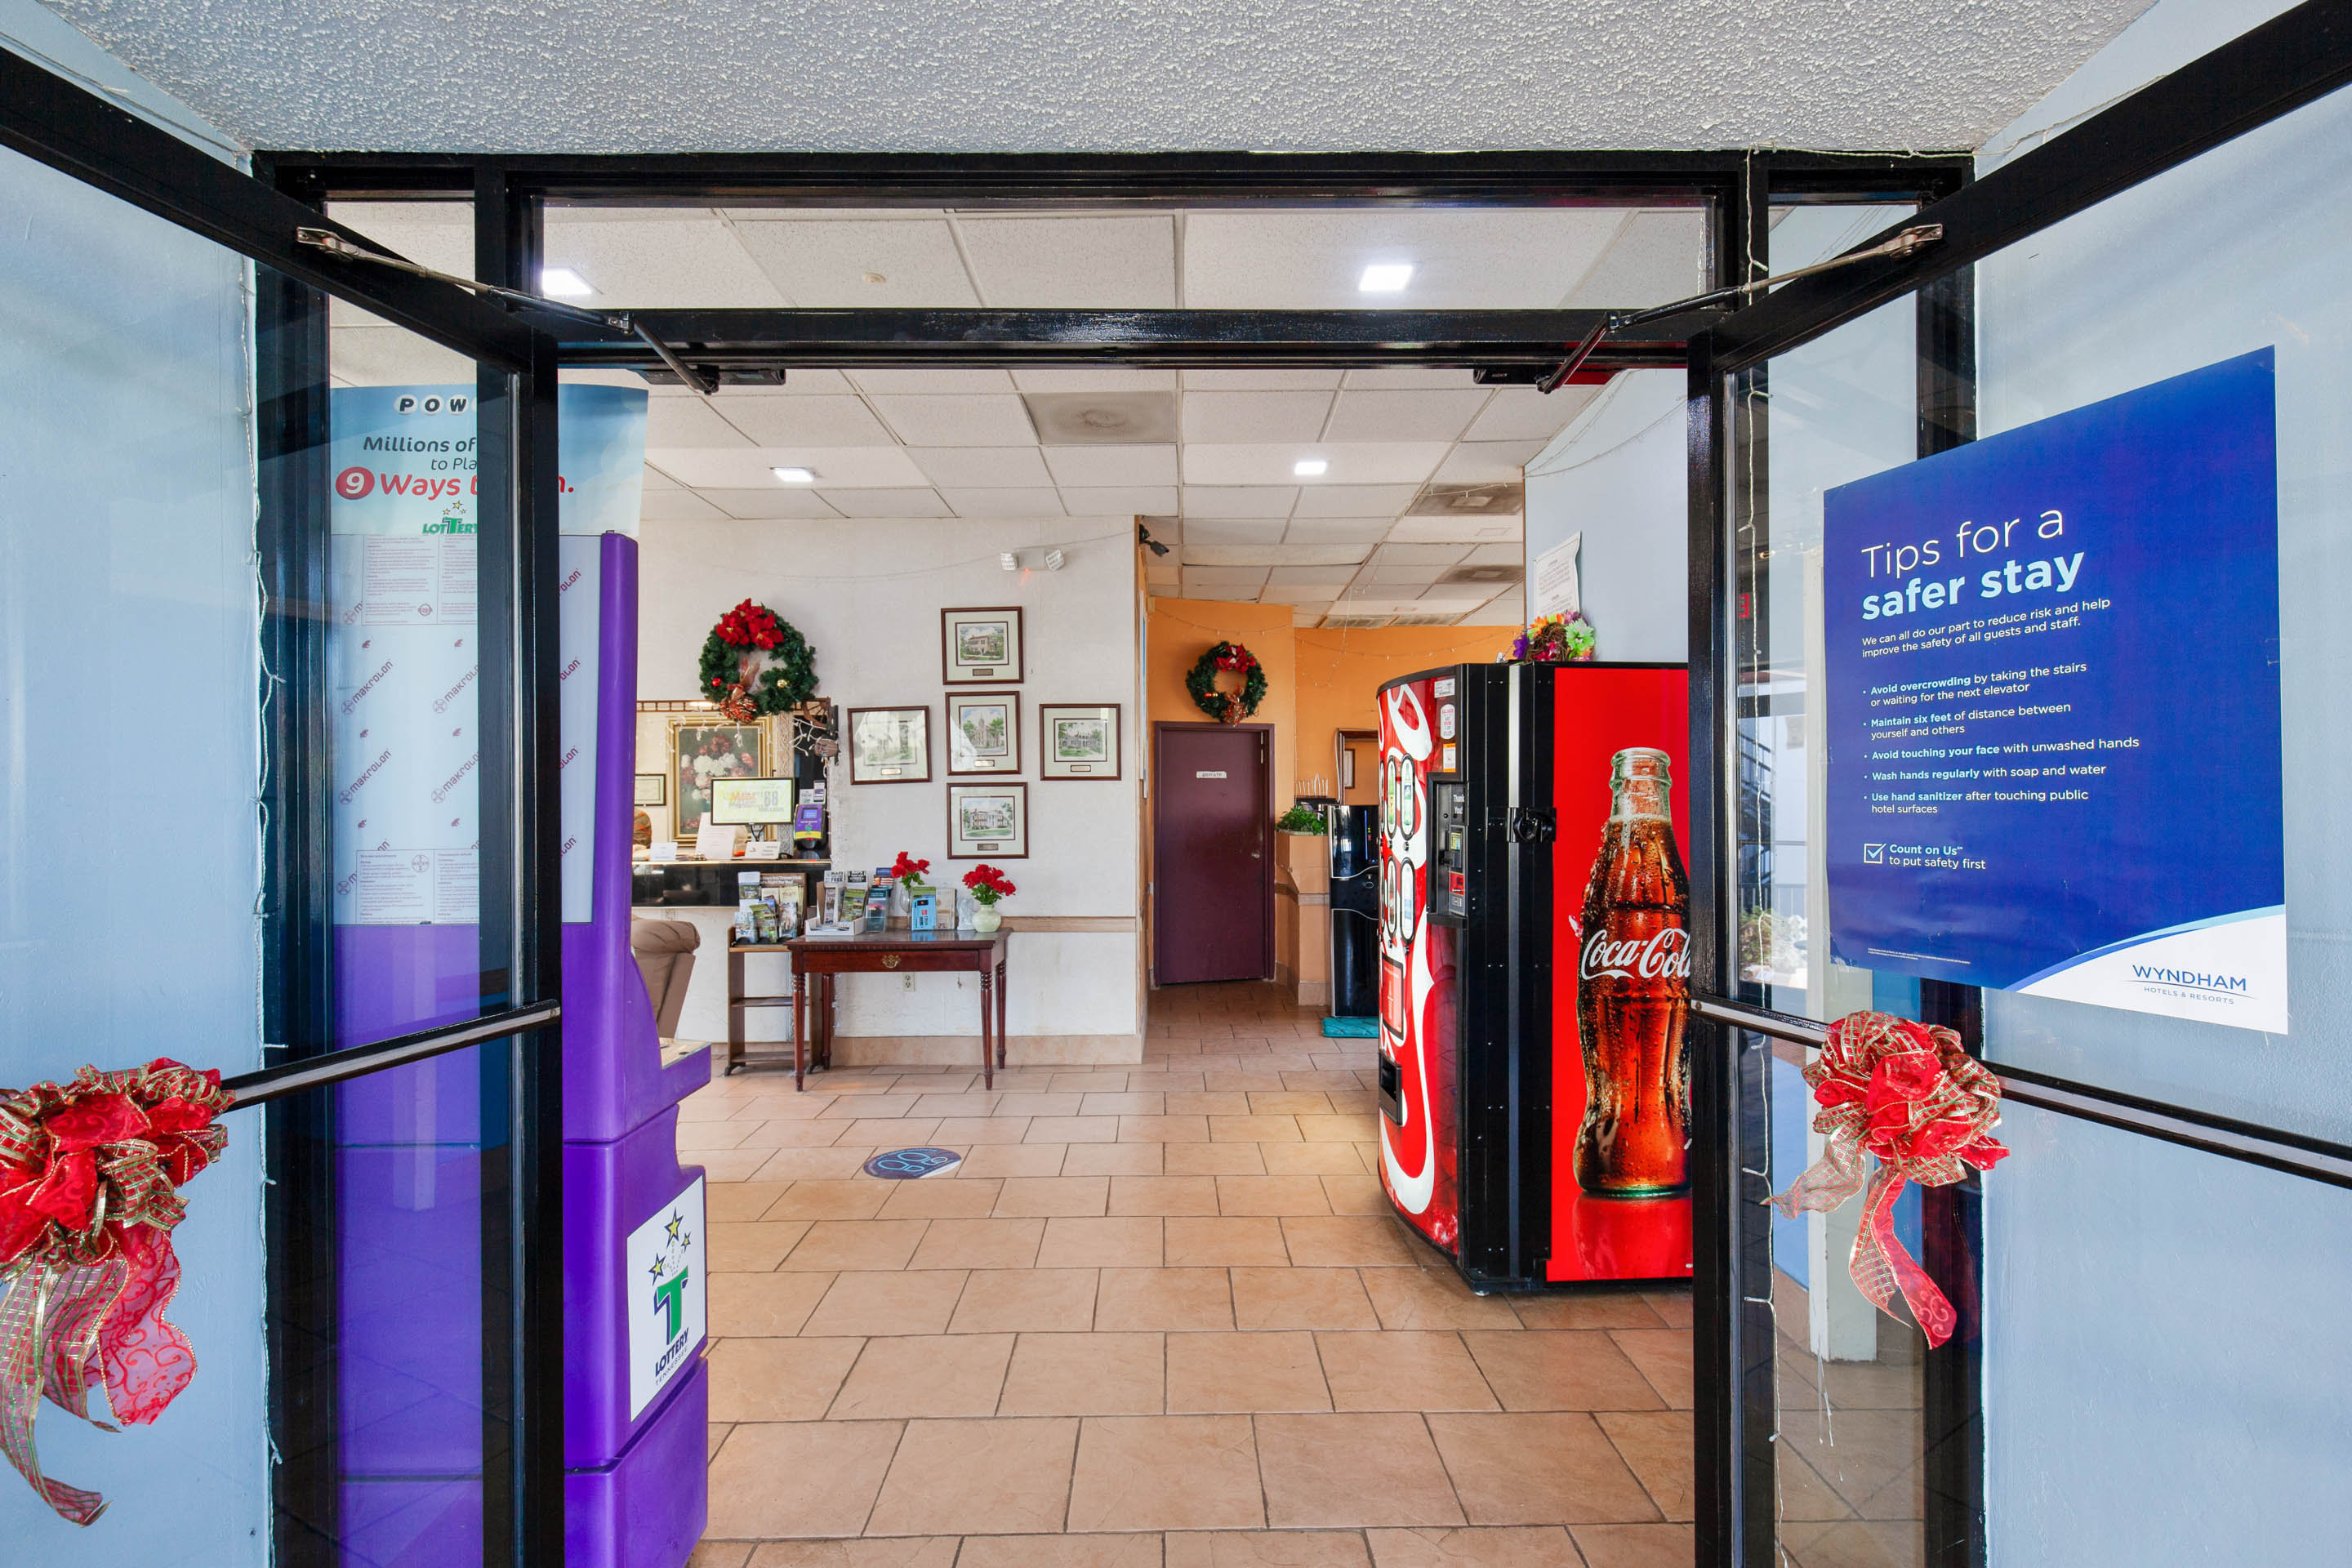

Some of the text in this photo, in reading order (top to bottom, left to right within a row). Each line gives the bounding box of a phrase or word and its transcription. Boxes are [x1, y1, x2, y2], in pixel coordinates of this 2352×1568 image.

[363, 436, 477, 452] Millions of
[431, 458, 477, 470] to Pla
[345, 473, 365, 493] 9
[381, 474, 461, 501] Ways
[1861, 510, 2063, 578] Tips for a
[1862, 552, 2084, 620] safer stay
[1862, 598, 2110, 646] We can all do our part to reduce risk and help
[1862, 616, 2081, 657] improve the safety of all guests and staff.
[1871, 663, 2087, 695] Avoid overcrowding by taking the stairs
[1883, 695, 1918, 706] waiting
[1921, 693, 1935, 702] for
[1937, 691, 1954, 700] the
[1958, 688, 1981, 697] next
[1984, 684, 2030, 695] elevator
[1872, 704, 2071, 727] Maintain six feet of distance between
[1871, 725, 1965, 740] yourself and others
[1872, 737, 2140, 760] Avoid touching your face with unwashed hands
[1872, 764, 2107, 780] Wash hands regularly with soap and water
[1872, 789, 2089, 802] Use hand sanitizer after touching public
[1872, 804, 1937, 813] hotel surfaces
[1890, 844, 1922, 854] Count
[1889, 856, 1986, 869] to put safety first
[2132, 964, 2247, 991] WYNDHAM
[2144, 987, 2178, 997] HOTELS
[2189, 992, 2234, 1004] RESORTS
[655, 1327, 689, 1378] LOTTERY
[655, 1345, 688, 1386] TENNESSEE
